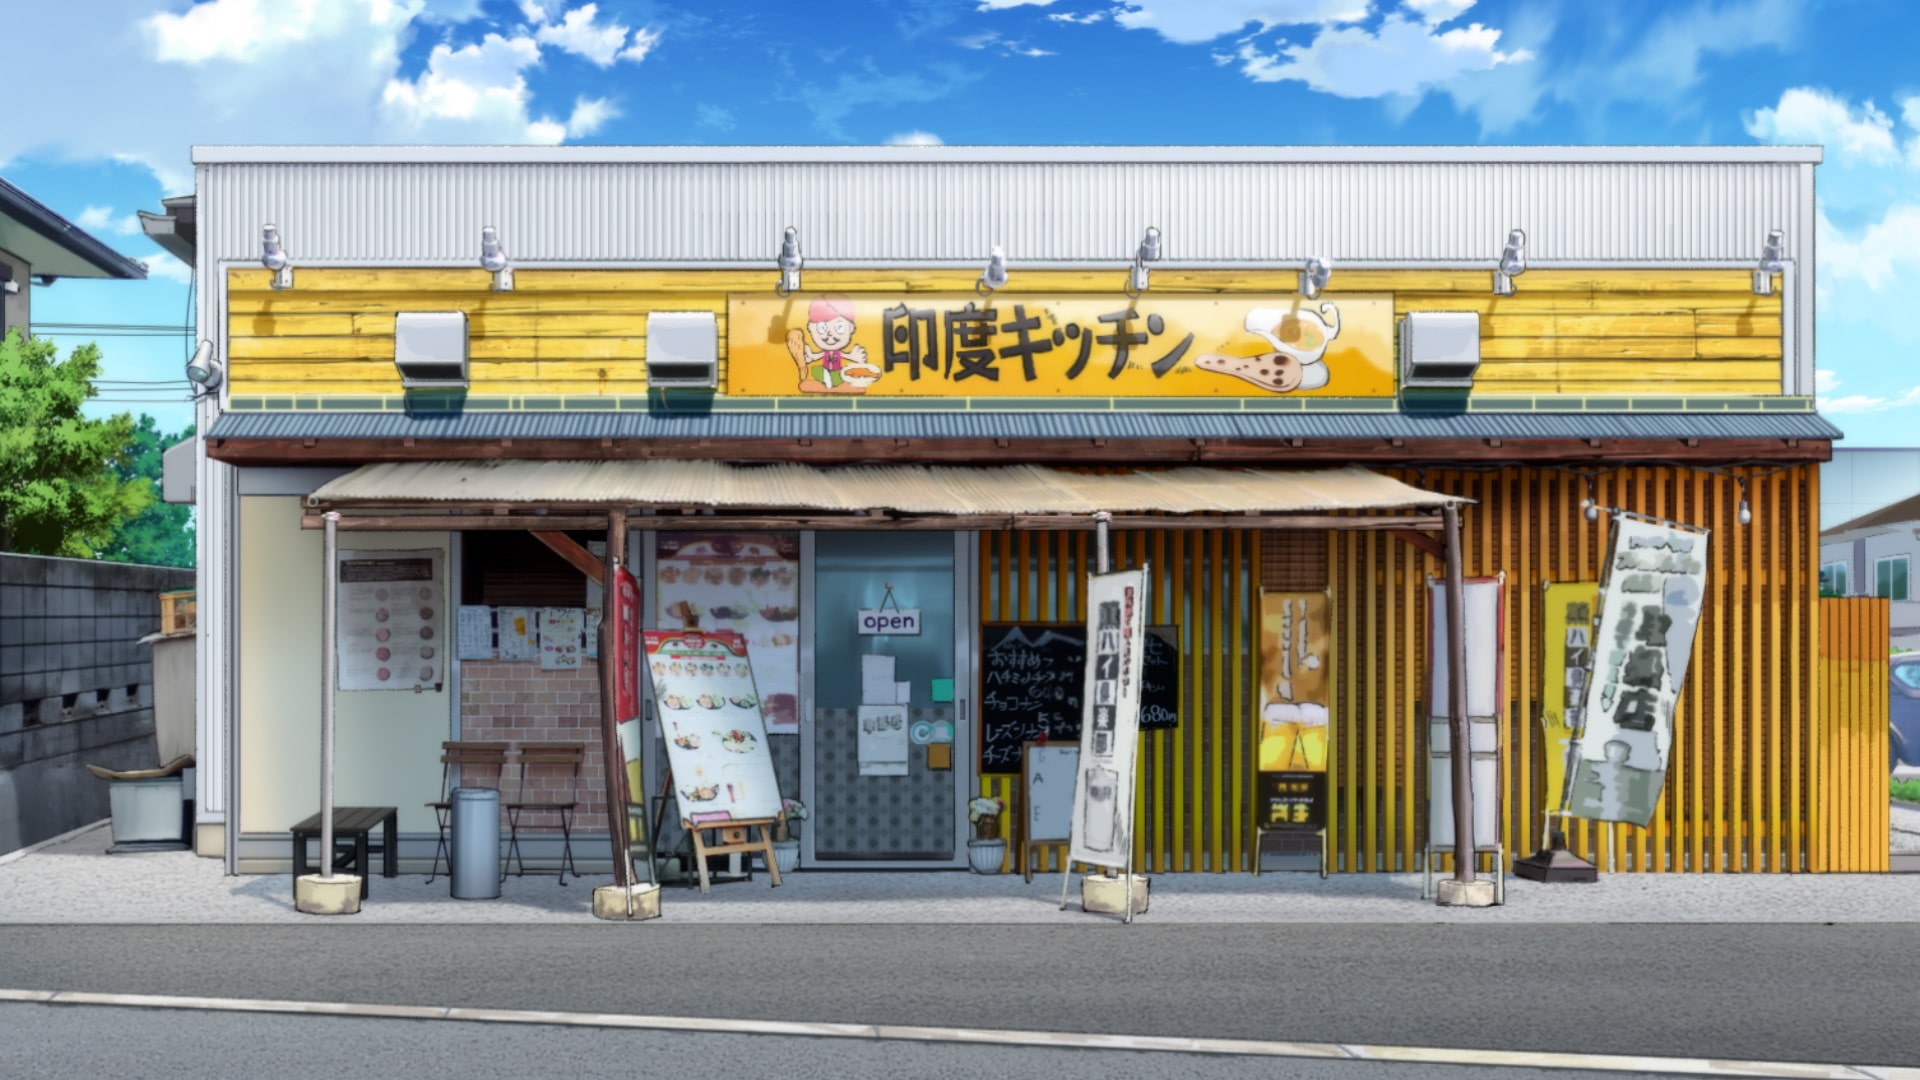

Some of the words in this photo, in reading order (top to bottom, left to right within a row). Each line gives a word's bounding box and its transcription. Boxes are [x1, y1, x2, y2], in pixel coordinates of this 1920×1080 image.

[882, 302, 1194, 381] 印度キッチン
[863, 615, 915, 632] open
